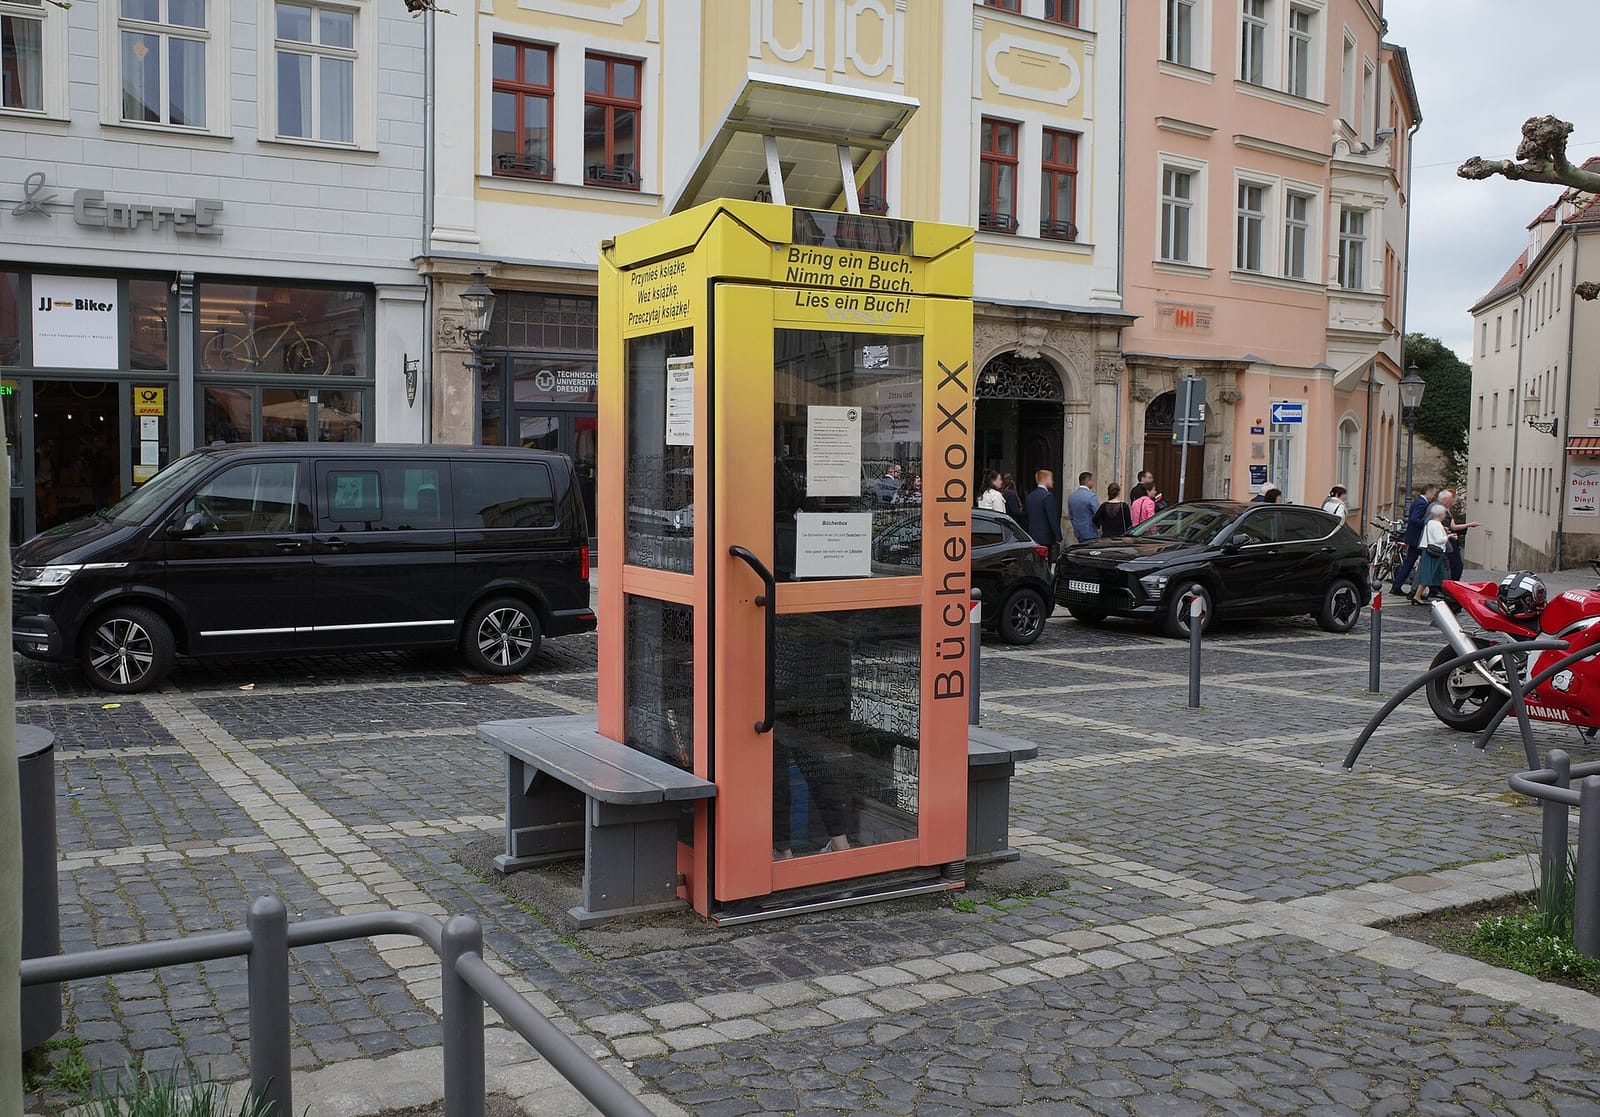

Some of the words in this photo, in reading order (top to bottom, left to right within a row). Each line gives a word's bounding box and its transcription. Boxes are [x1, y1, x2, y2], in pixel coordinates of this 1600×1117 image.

[788, 248, 833, 270] Bring
[839, 253, 863, 269] ein
[868, 256, 913, 275] Buch.
[786, 267, 834, 285] Nimm
[840, 273, 864, 288] ein
[869, 275, 914, 292] Buch.
[39, 297, 52, 311] JJ
[75, 299, 114, 312] Bikes
[795, 291, 830, 308] Lies
[835, 296, 859, 310] ein
[864, 296, 911, 313] Buch!
[628, 306, 661, 326] Przeczytaj
[1572, 479, 1599, 487] Bücher
